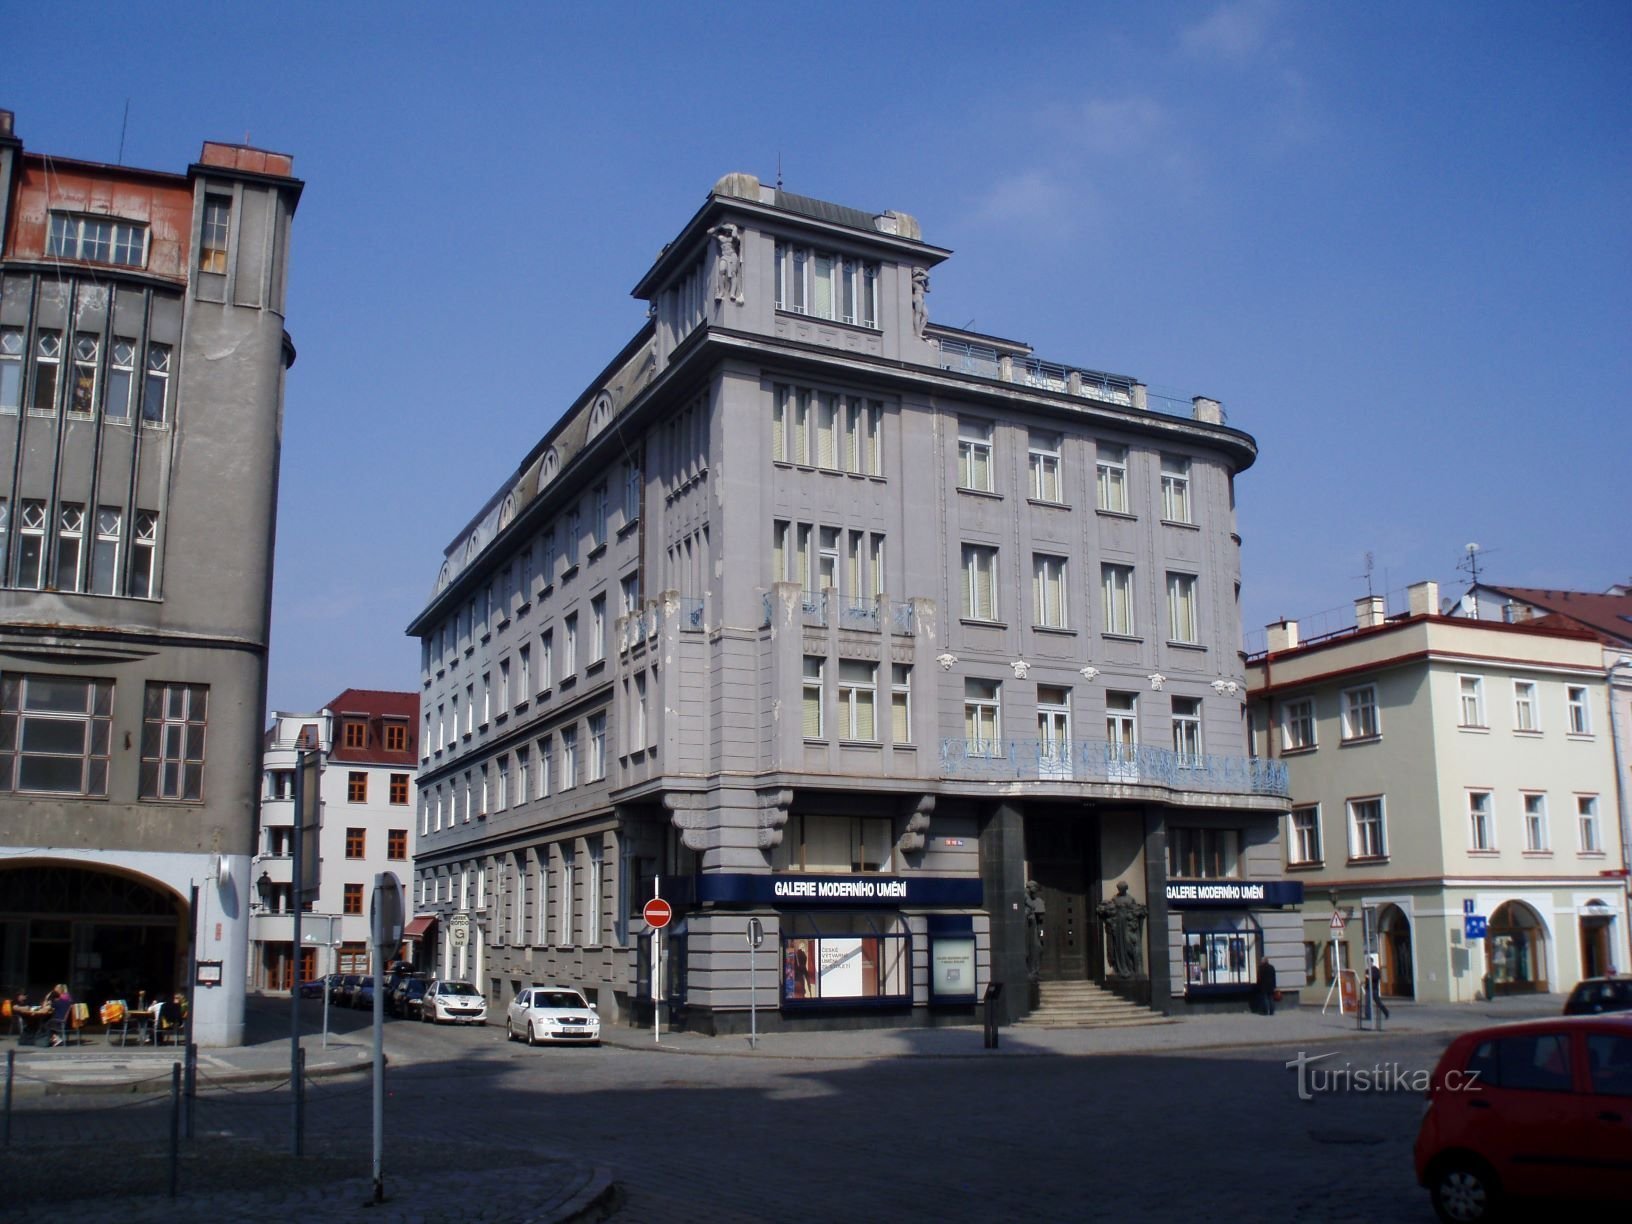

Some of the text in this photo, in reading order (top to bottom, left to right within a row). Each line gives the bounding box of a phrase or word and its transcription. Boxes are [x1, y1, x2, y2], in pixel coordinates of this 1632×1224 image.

[774, 881, 907, 897] GALERIE MODERNÍHO UMĚNÍ
[1166, 884, 1264, 899] GALERIE MODERNÍHO UMĚNÍ
